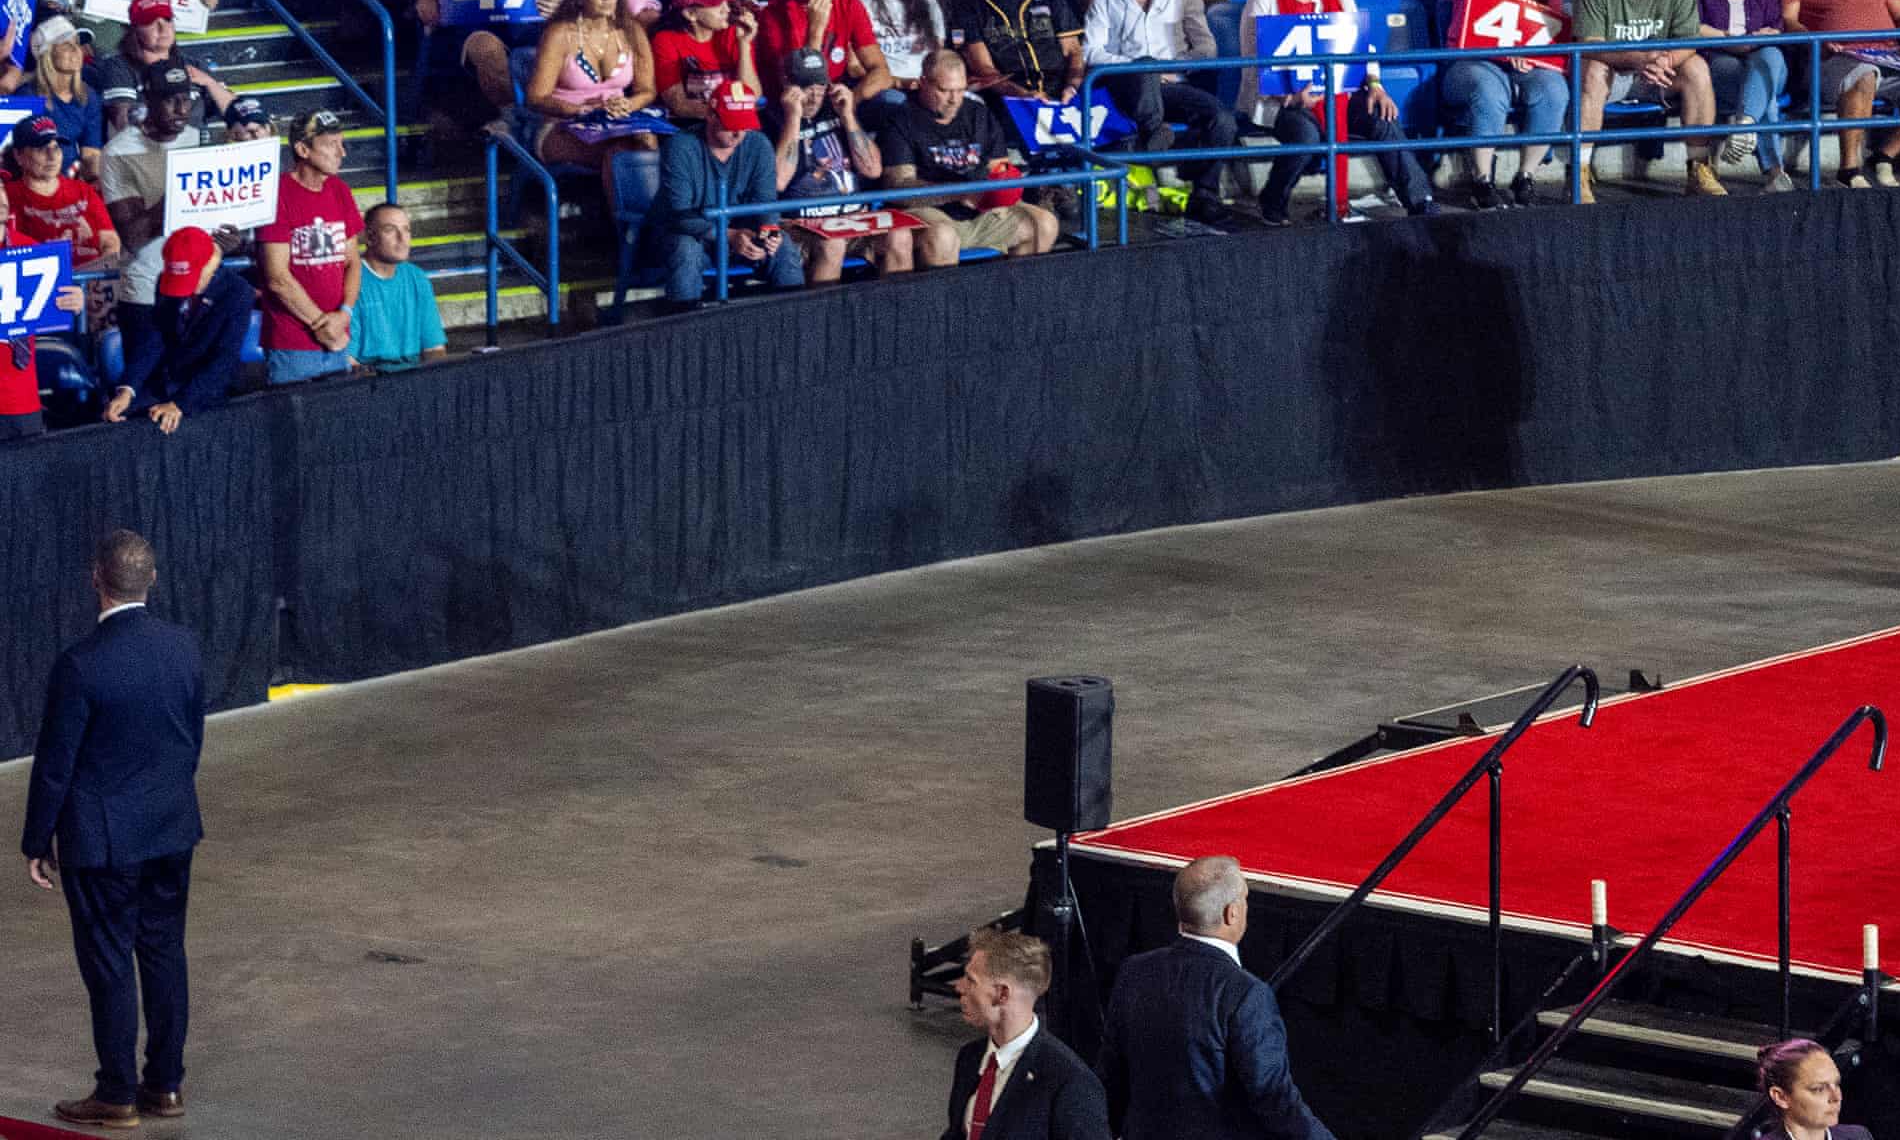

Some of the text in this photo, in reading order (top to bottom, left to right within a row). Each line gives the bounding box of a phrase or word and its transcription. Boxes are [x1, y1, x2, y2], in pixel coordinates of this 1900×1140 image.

[1613, 18, 1664, 42] TRUMP
[1271, 24, 1360, 82] 47
[176, 162, 272, 191] TRUMP
[188, 183, 262, 207] VANCE
